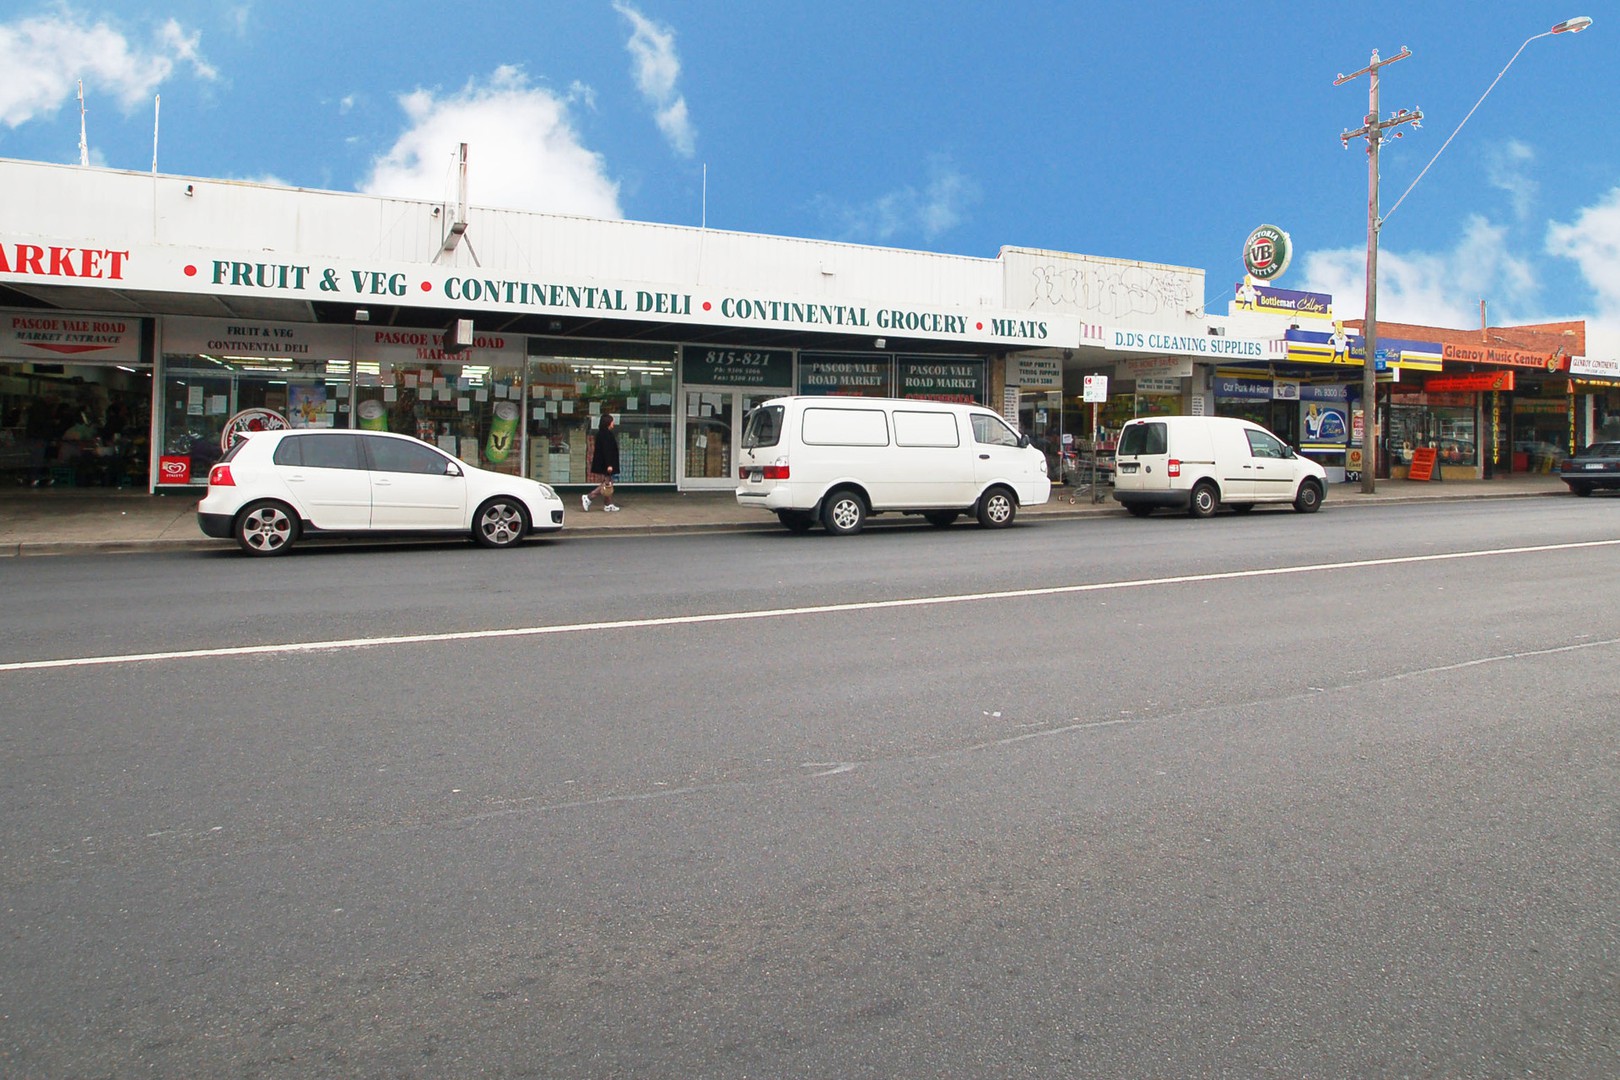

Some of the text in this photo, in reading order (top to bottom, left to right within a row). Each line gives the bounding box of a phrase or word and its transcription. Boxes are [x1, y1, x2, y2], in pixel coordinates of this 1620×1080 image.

[1248, 230, 1279, 245] VICTORIA
[1251, 244, 1271, 262] VB
[211, 260, 407, 297] FRUIT & VEG
[444, 277, 692, 315] CONTINENTAL DELI
[1261, 295, 1295, 308] Bottlemart
[721, 297, 968, 334] CONTINENTAL GROCERY
[12, 317, 126, 334] PASCOE VALE ROAD
[227, 326, 294, 338] FRUIT & VEG
[990, 318, 1049, 340] MEATS
[15, 331, 122, 344] MARKET ENTRANCE
[374, 332, 428, 346] PASCOE
[473, 337, 504, 345] OAD
[1115, 332, 1262, 356] D.D'S CLEANING SUPPLIES
[207, 340, 309, 353] CONTINENTAL DELI
[705, 351, 770, 366] 815-821
[1445, 345, 1543, 365] Glenroy Music Centre
[812, 363, 878, 373] PASCOE VALE
[909, 365, 973, 376] PASCOE VALE
[807, 375, 882, 386] ROAD MARKET
[905, 377, 977, 388] ROAD MARKET
[1223, 383, 1233, 392] Car
[1234, 383, 1248, 393] Park
[1256, 386, 1270, 394] Rear
[1492, 407, 1500, 464] QUALITY
